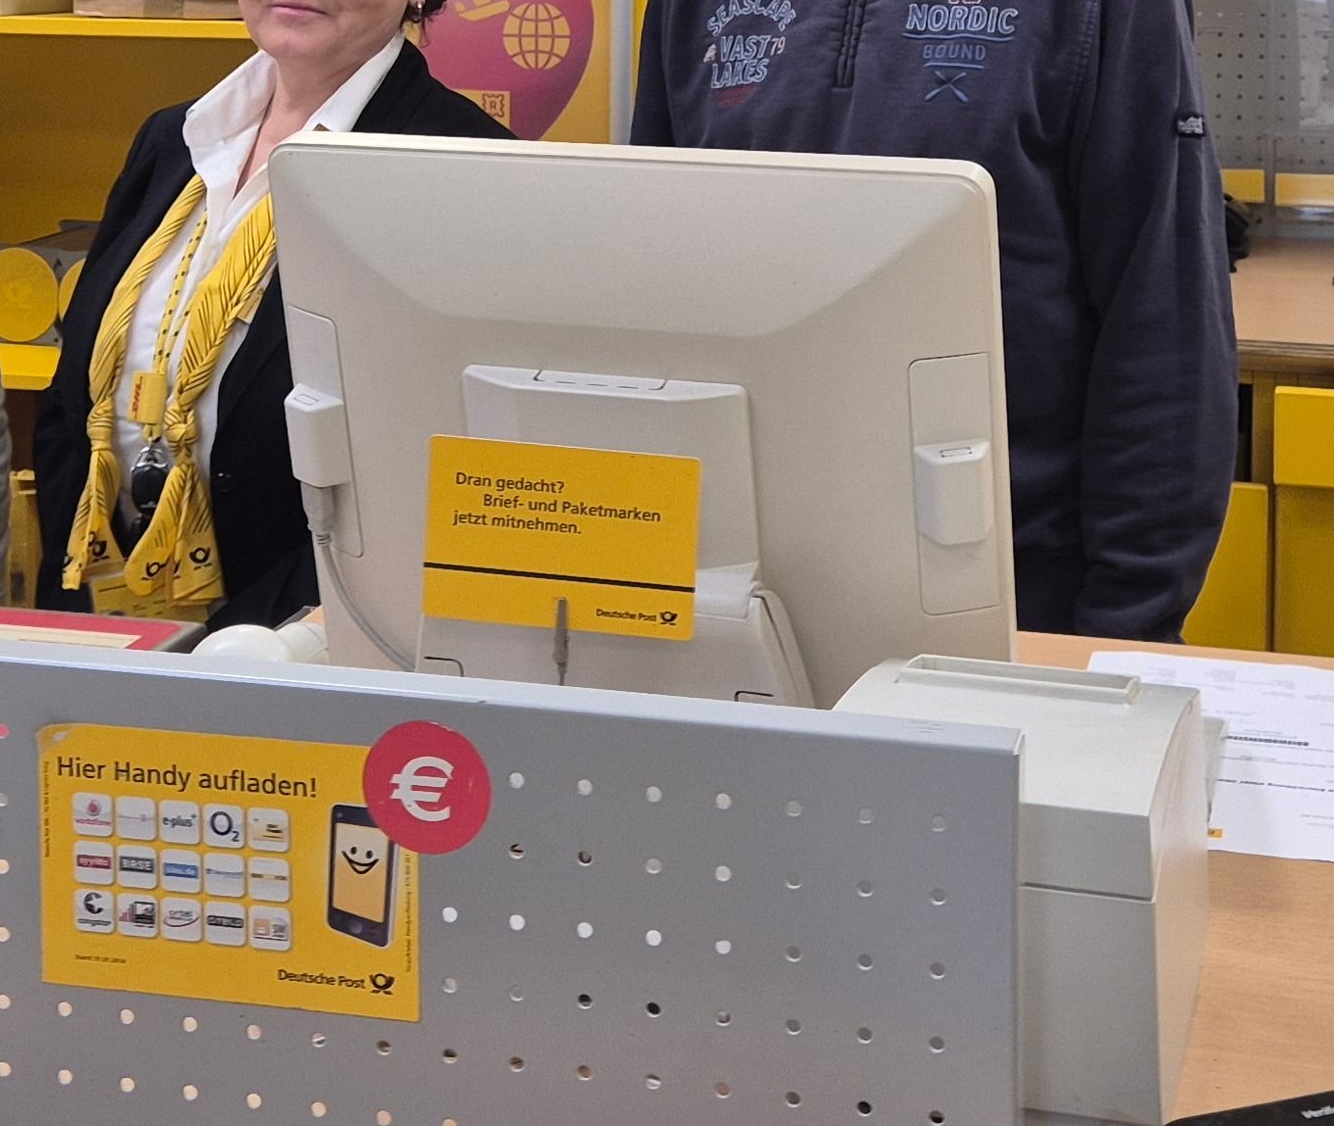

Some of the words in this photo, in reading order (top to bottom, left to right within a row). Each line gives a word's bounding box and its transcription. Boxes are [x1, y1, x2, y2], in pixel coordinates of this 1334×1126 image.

[906, 3, 1019, 34] NORDIC
[720, 34, 771, 62] VAST
[770, 36, 786, 56] 79
[922, 43, 987, 61] BOUND
[710, 58, 770, 89] LAKES
[455, 471, 491, 488] Dran
[496, 476, 565, 494] gedacht?
[482, 493, 524, 509] Brief-
[528, 499, 557, 513] und
[561, 500, 661, 523] Paketmarken
[452, 509, 488, 526] jetzt
[491, 513, 582, 535] mitnehmen.
[595, 607, 636, 622] Deutsche
[638, 612, 657, 623] Post
[56, 756, 106, 780] Hier
[113, 761, 191, 792] Handy
[197, 769, 317, 798] aufladen!
[277, 968, 336, 986] Deutsche
[337, 975, 366, 990] Post
